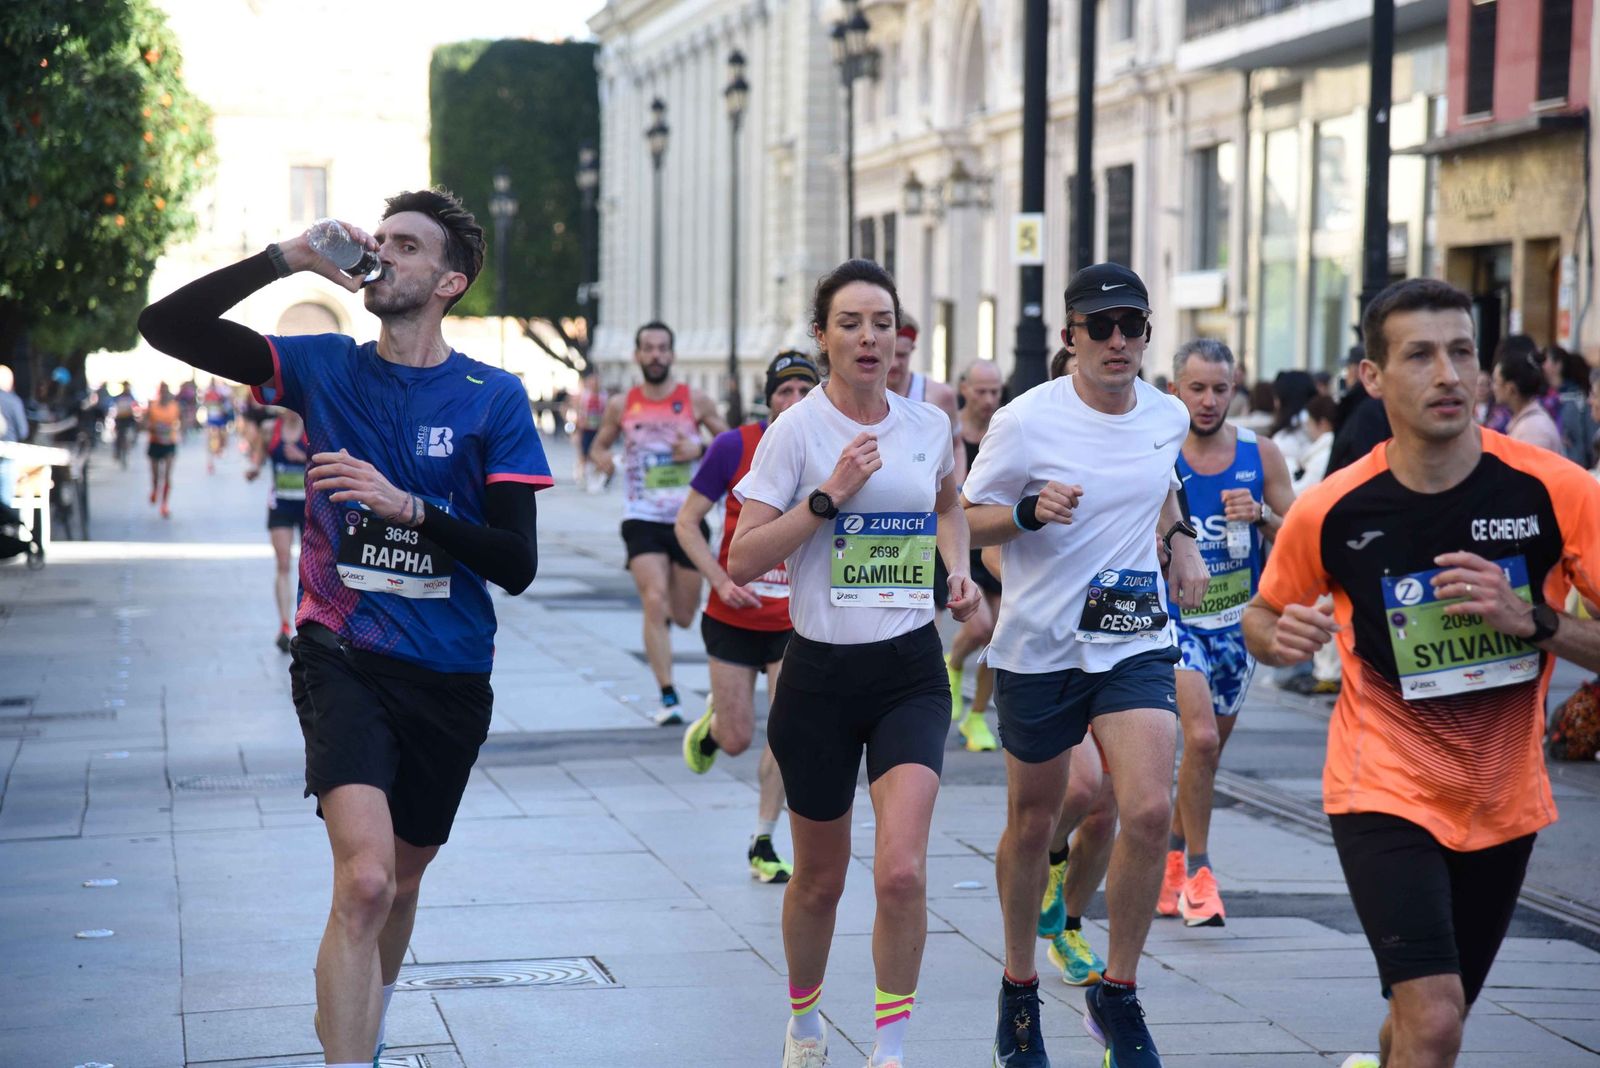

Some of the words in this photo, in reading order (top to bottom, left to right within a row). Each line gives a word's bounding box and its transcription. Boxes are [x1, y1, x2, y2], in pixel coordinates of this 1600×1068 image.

[870, 518, 924, 530] ZURICH
[1471, 519, 1488, 541] CE
[385, 526, 418, 545] 3643
[361, 543, 433, 574] RAPHA
[870, 546, 899, 558] 2698
[843, 564, 924, 584] CAMILLE
[1413, 631, 1524, 668] SYLVAIN
